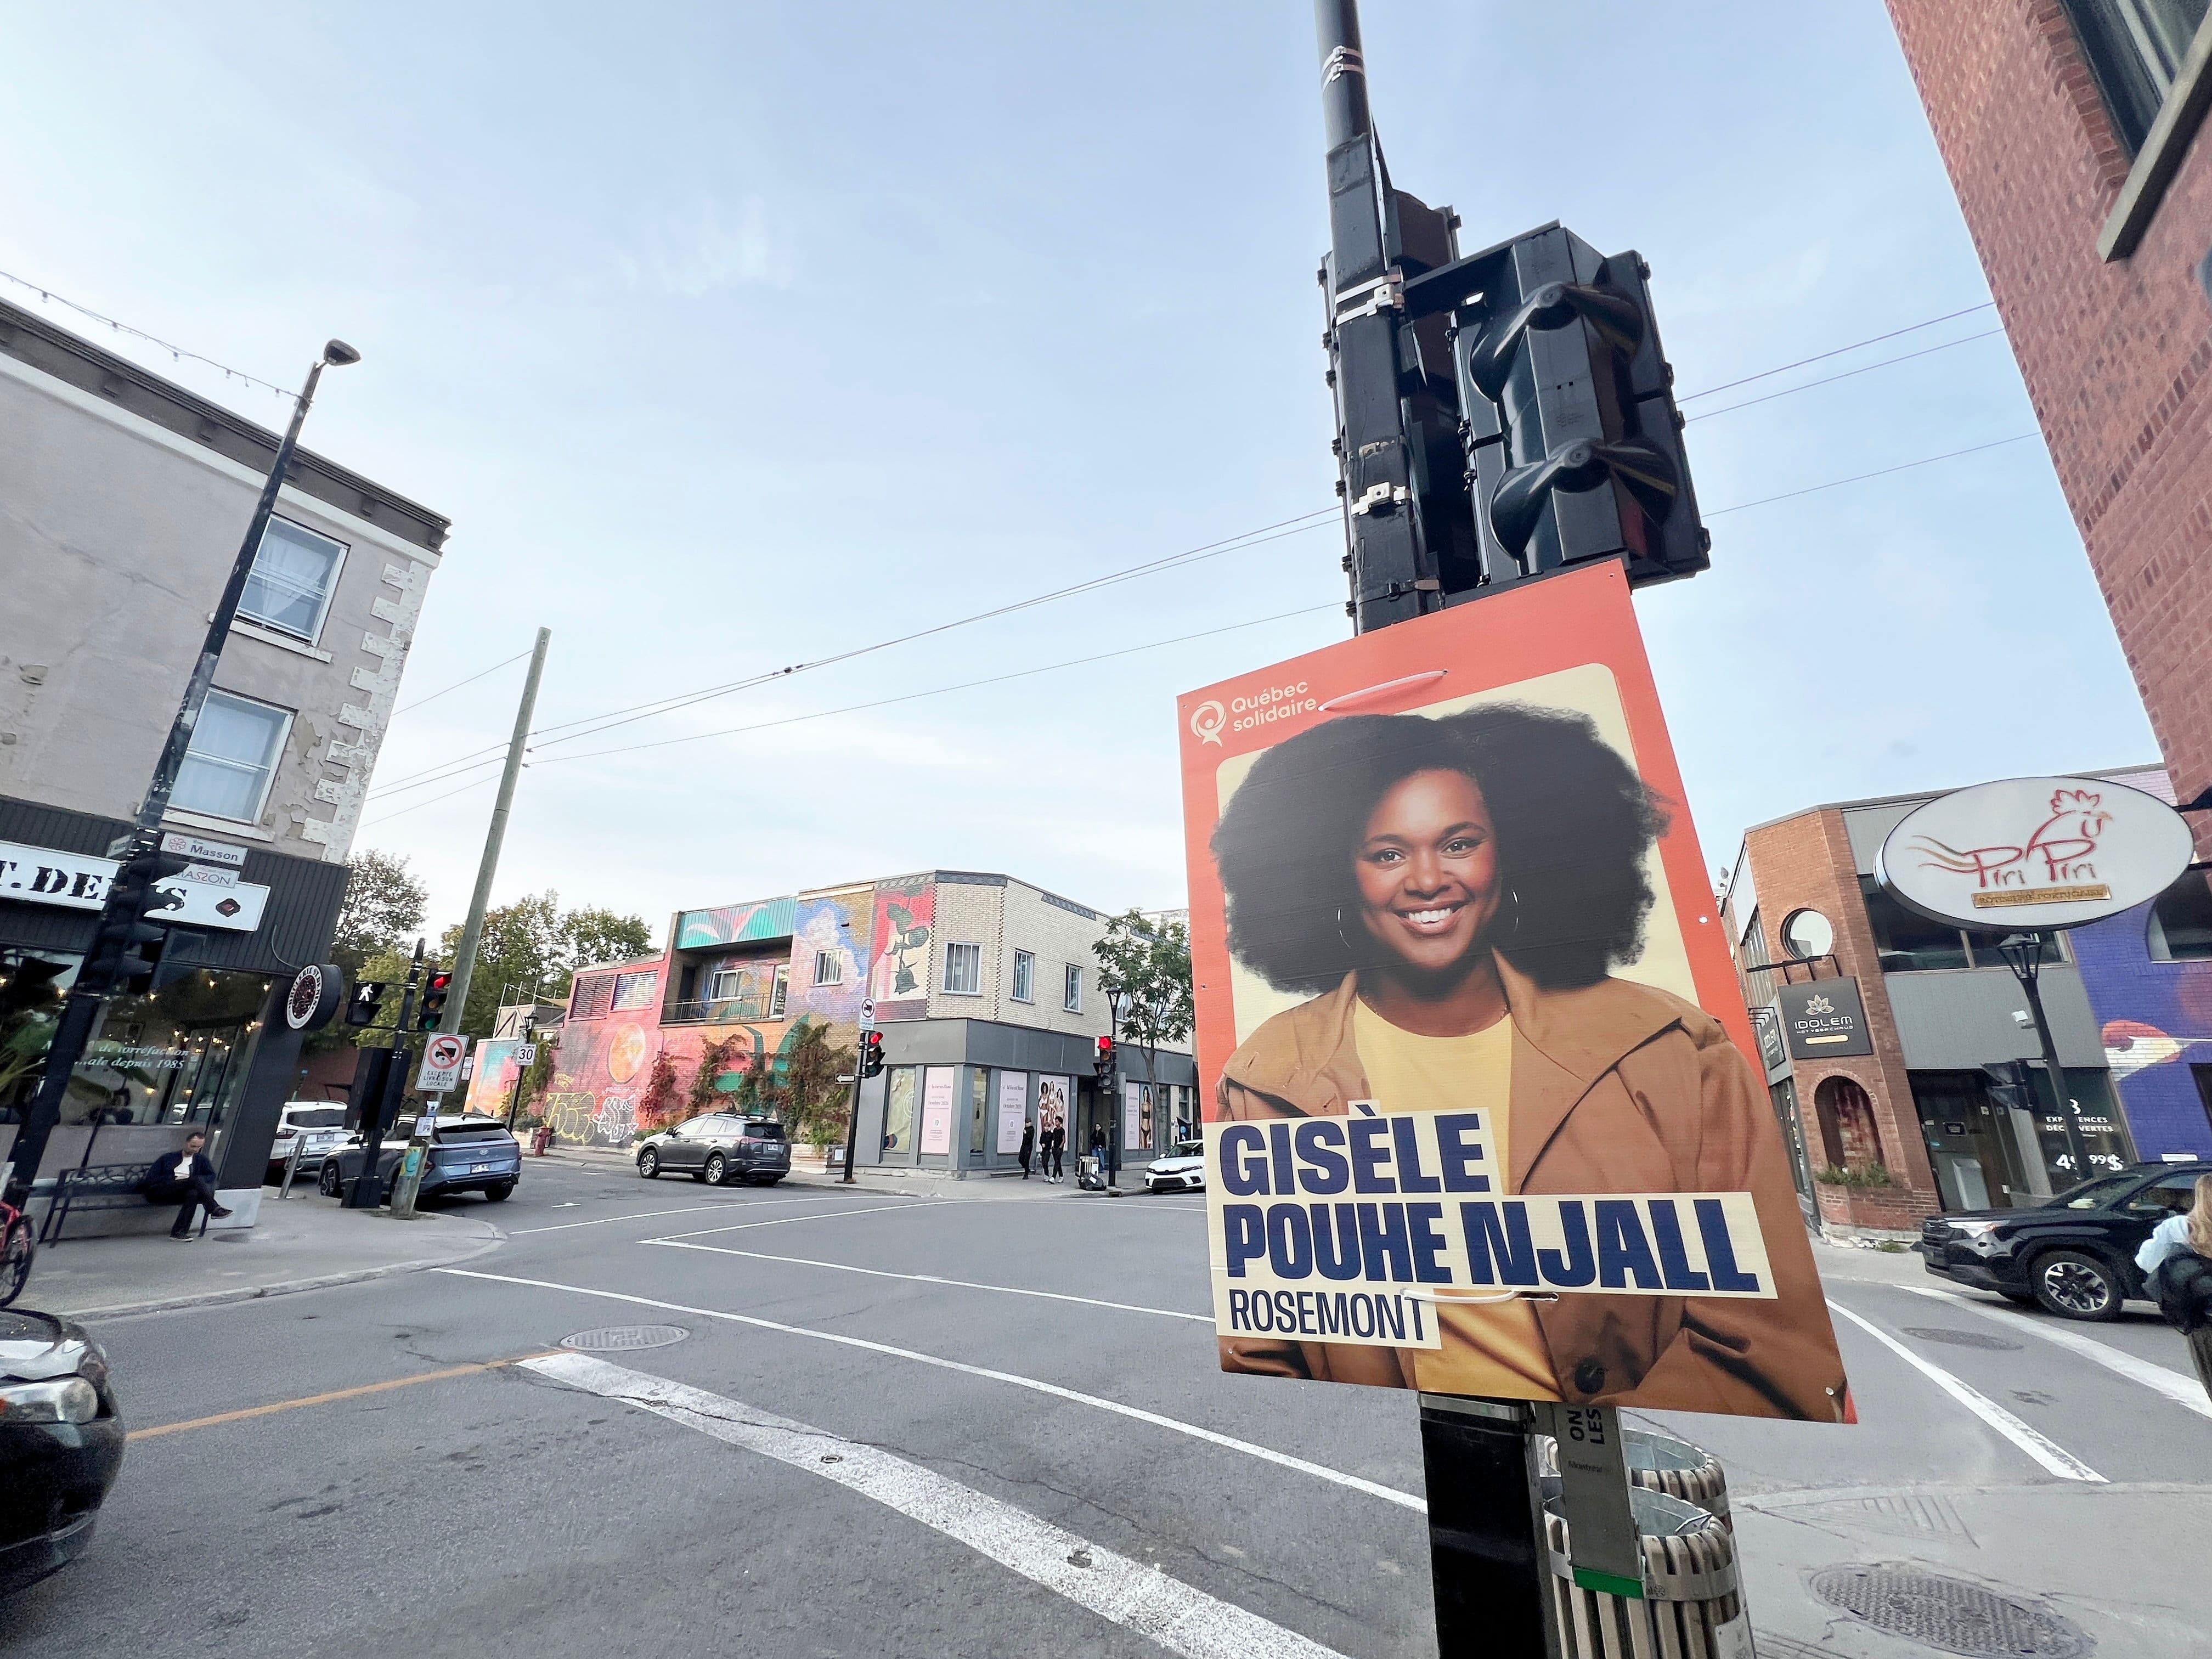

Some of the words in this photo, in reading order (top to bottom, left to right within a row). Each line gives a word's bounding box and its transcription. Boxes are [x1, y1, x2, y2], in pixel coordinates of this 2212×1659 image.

[1231, 681, 1308, 713] Québec
[1233, 698, 1317, 732] solidaire
[190, 845, 238, 861] Masson
[1961, 846, 2025, 888] Piri
[2028, 839, 2097, 882] Piri
[1794, 1016, 1853, 1029] IDOLEM
[111, 1057, 151, 1069] depuis
[156, 1059, 185, 1069] 1985
[518, 1048, 533, 1060] 30
[2069, 1098, 2081, 1115] 3
[2046, 1124, 2114, 1132] DÉCVERTES
[1220, 1104, 1491, 1196] GISÈLE
[1223, 1201, 1452, 1283] POUHE
[1459, 1199, 1760, 1292] NJALL
[1229, 1289, 1426, 1341] ROSEMONT
[1567, 1410, 1584, 1441] ON
[1585, 1408, 1605, 1444] LES
